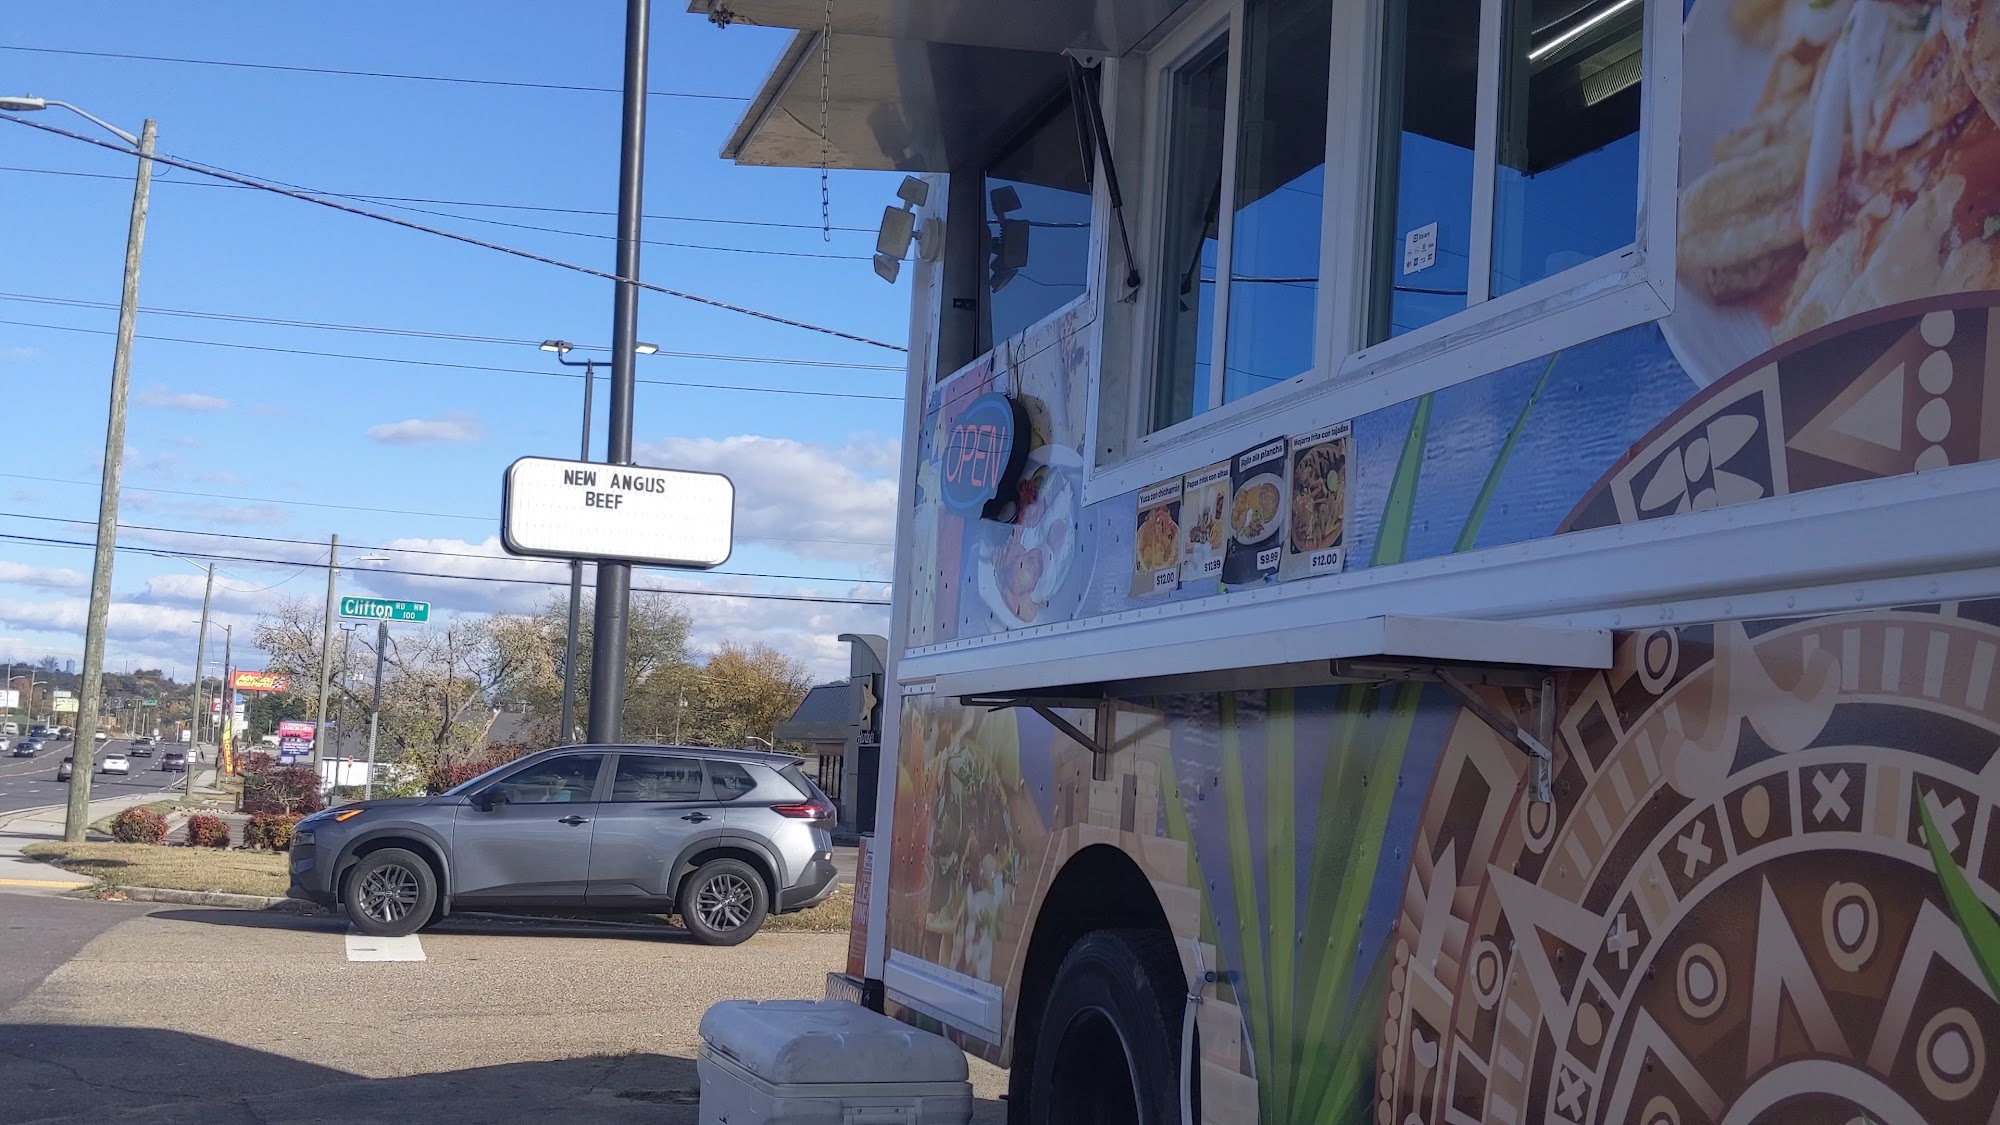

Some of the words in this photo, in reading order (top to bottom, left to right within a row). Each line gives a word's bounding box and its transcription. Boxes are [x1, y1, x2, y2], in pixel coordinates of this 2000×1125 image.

[1332, 425, 1348, 436] tajadas
[946, 424, 1006, 489] OPEN
[1261, 445, 1282, 460] plancha
[563, 470, 597, 487] NEW
[610, 473, 666, 494] ANGUS
[585, 491, 623, 510] BEEF
[1150, 492, 1158, 500] con
[1260, 551, 1278, 565] $9.99
[1312, 553, 1337, 567] $12.00
[1156, 572, 1174, 586] $12.00
[345, 600, 393, 618] Clifton
